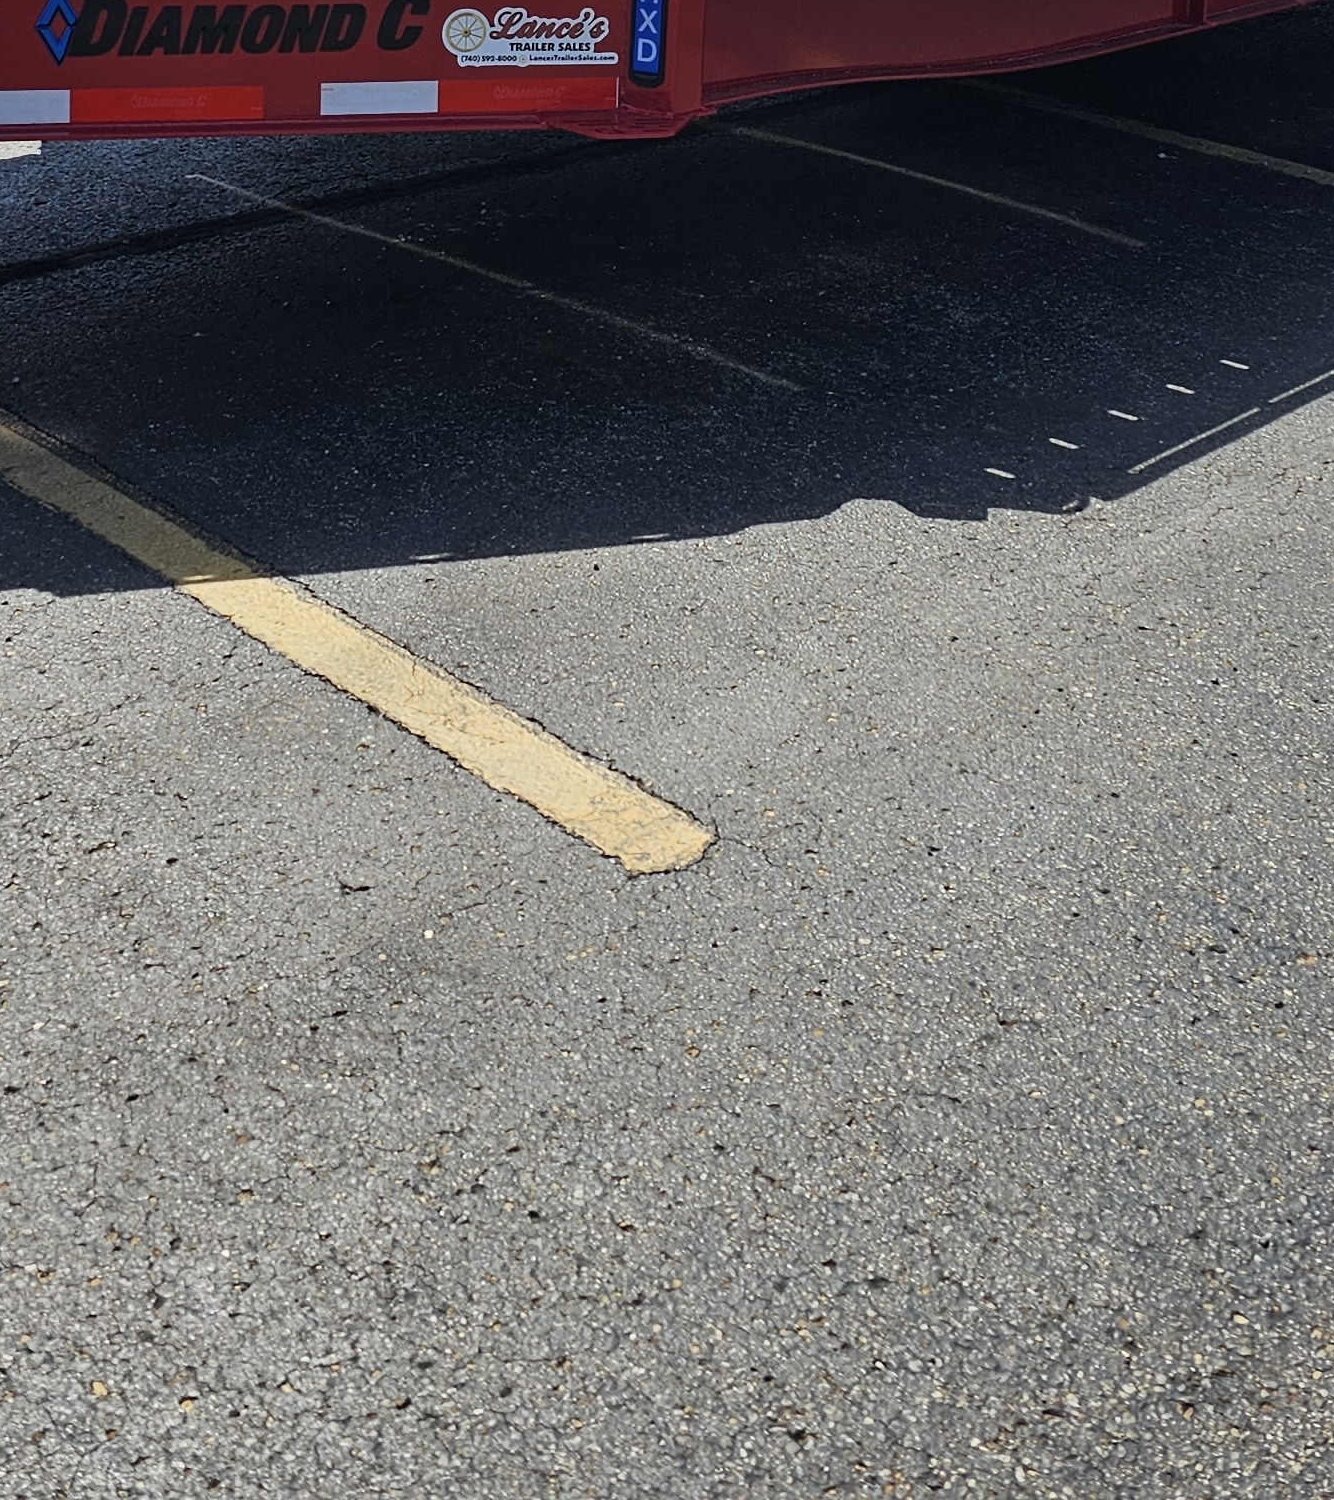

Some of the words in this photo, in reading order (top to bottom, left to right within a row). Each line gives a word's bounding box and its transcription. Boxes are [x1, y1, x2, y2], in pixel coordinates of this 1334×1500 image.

[489, 11, 606, 40] Lance's
[509, 42, 555, 51] TRAILER
[558, 42, 591, 51] SALES
[460, 55, 480, 63] (740)
[530, 54, 615, 62] LancesTrailerSales.com
